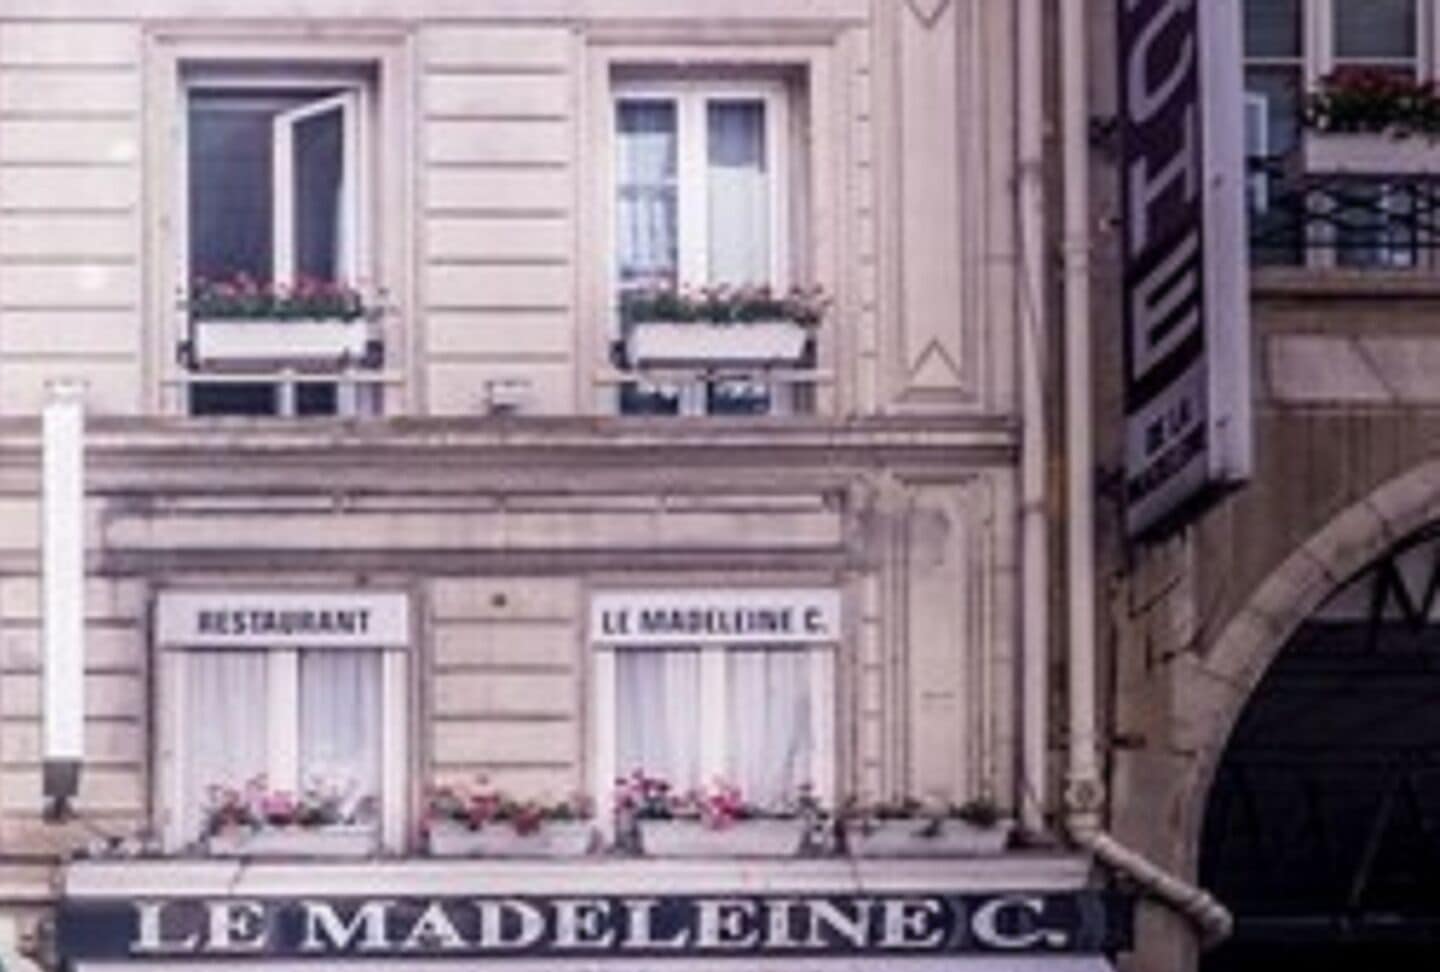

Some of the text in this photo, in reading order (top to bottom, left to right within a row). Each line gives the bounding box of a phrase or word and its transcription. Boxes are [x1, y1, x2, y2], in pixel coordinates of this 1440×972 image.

[197, 610, 369, 635] RESTAURANT
[601, 610, 630, 635] LE
[638, 609, 791, 635] MADELEINE
[129, 896, 1067, 952] LE MADELEINE C.
